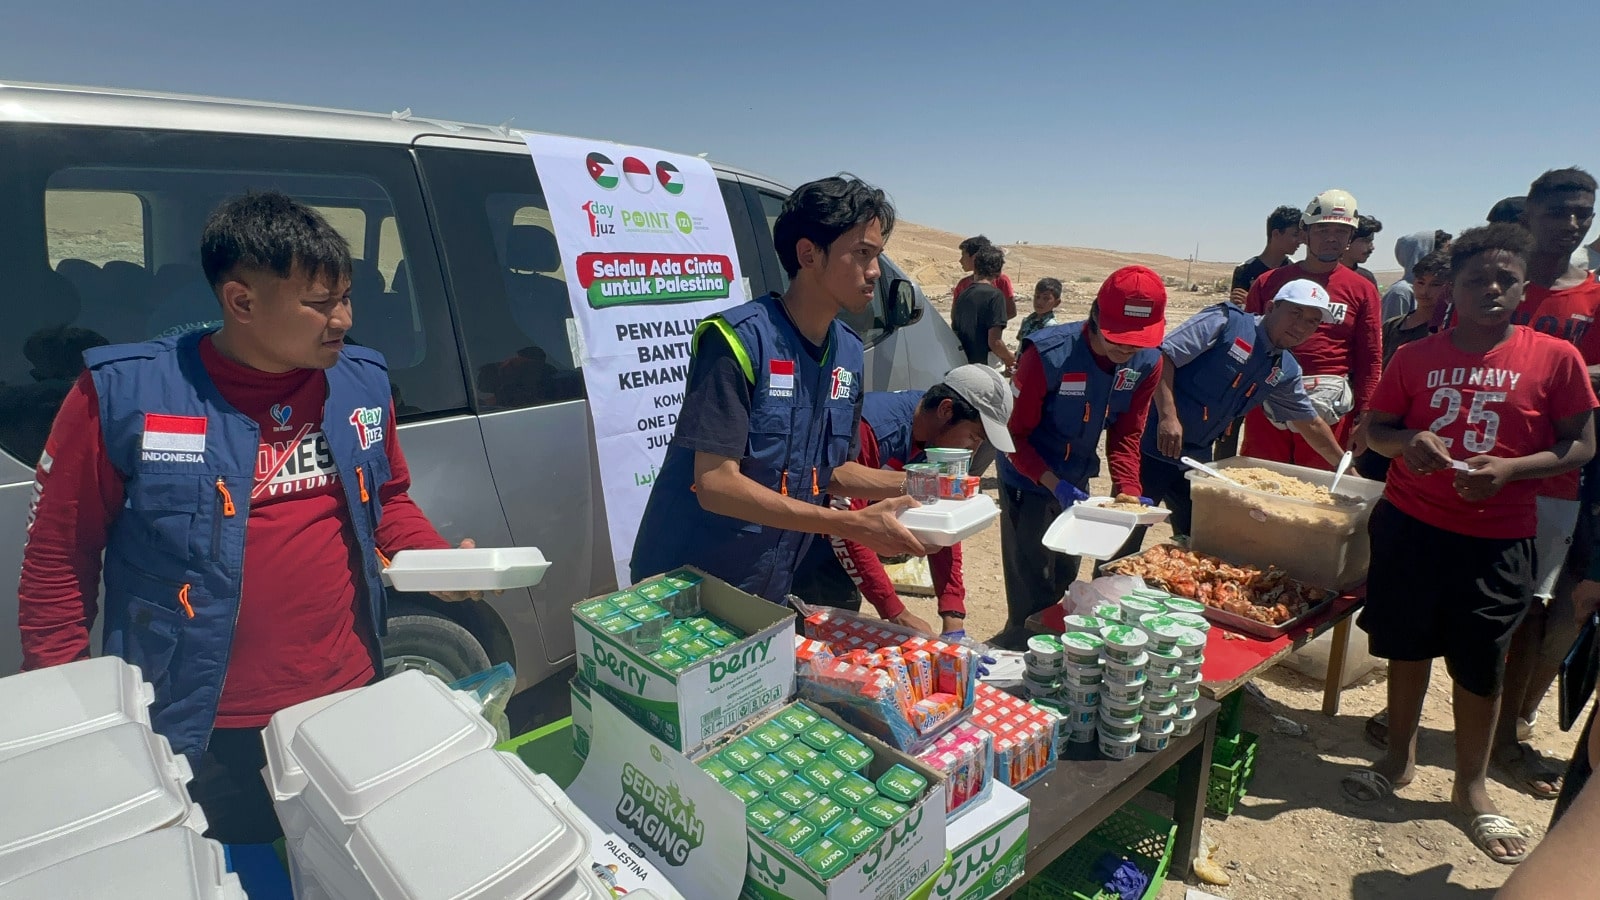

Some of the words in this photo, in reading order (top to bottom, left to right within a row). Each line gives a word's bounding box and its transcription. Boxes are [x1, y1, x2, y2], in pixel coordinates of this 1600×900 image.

[591, 202, 614, 218] day
[621, 210, 668, 229] POINT
[596, 220, 615, 237] juz
[593, 260, 646, 277] Selalu
[651, 258, 681, 276] Ada
[685, 257, 722, 274] Cinta
[601, 278, 652, 296] untuk
[656, 274, 724, 293] Palestina
[1427, 367, 1466, 388] OLD
[1468, 367, 1521, 391] NAVY
[360, 407, 382, 426] day
[637, 415, 666, 431] ONE
[1429, 387, 1507, 453] 25
[366, 427, 383, 449] juz
[141, 452, 204, 464] INDONESIA
[254, 435, 336, 481] ONES
[268, 473, 339, 496] VOLUNT
[592, 635, 647, 696] berry
[709, 636, 772, 683] berry
[785, 715, 804, 729] berry
[758, 733, 777, 747] berry
[810, 731, 830, 744] berry
[729, 750, 748, 766] berry
[784, 750, 804, 765] berry
[836, 749, 857, 765] berry
[755, 769, 775, 785] berry
[809, 769, 830, 786] berry
[840, 787, 861, 801] berry
[888, 780, 911, 795] berry
[622, 765, 701, 843] SEDEKAH
[780, 791, 800, 805] berry
[750, 811, 770, 825] berry
[819, 806, 842, 823] berry
[870, 806, 893, 820] berry
[618, 793, 690, 863] DAGING
[789, 825, 812, 844] berry
[851, 826, 874, 844] berry
[604, 840, 648, 882] PALESTINA
[820, 850, 844, 868] berry
